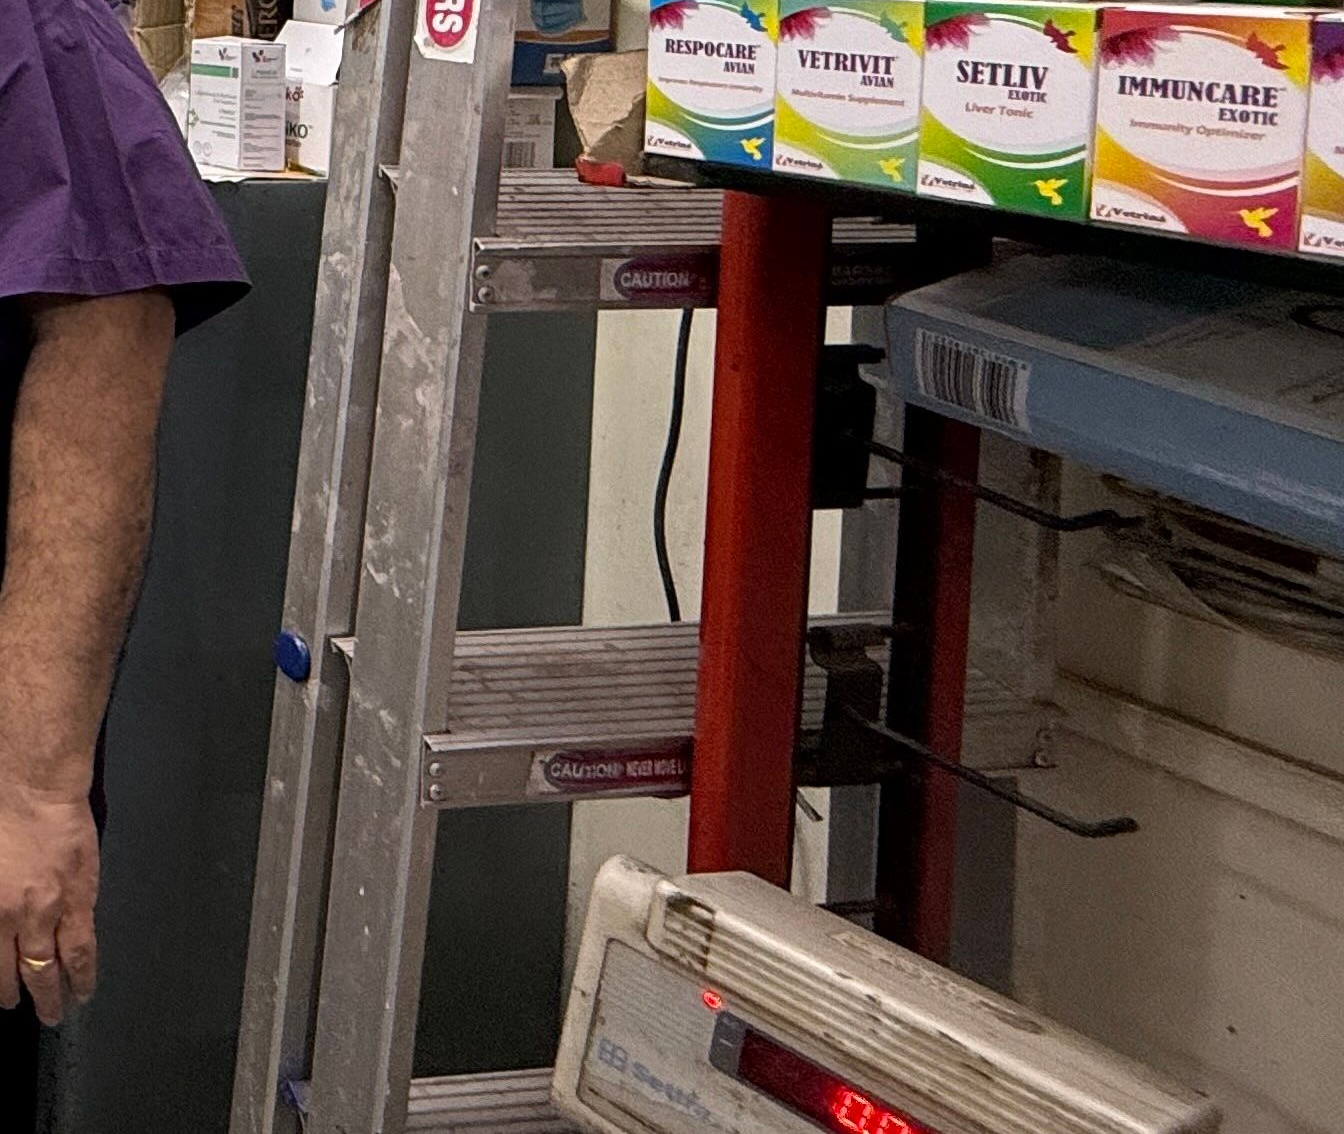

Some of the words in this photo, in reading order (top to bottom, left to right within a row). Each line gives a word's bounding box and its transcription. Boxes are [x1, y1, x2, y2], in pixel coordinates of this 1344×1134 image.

[665, 38, 758, 60] RESPOCARE
[723, 61, 755, 75] AVIAN
[798, 49, 897, 75] VETRIVIT
[860, 75, 894, 88] AVIAN
[956, 59, 1049, 90] SETLIV
[1008, 89, 1047, 103] EXOTIC
[1118, 75, 1279, 108] IMMUNCARE
[965, 102, 996, 114] Liver
[999, 105, 1034, 119] Tonic
[1218, 108, 1278, 126] EXOTIC
[1130, 119, 1193, 135] Immunity
[1196, 124, 1265, 141] Optimizer
[620, 272, 690, 288] CAUTION
[550, 762, 616, 779] CAUTION
